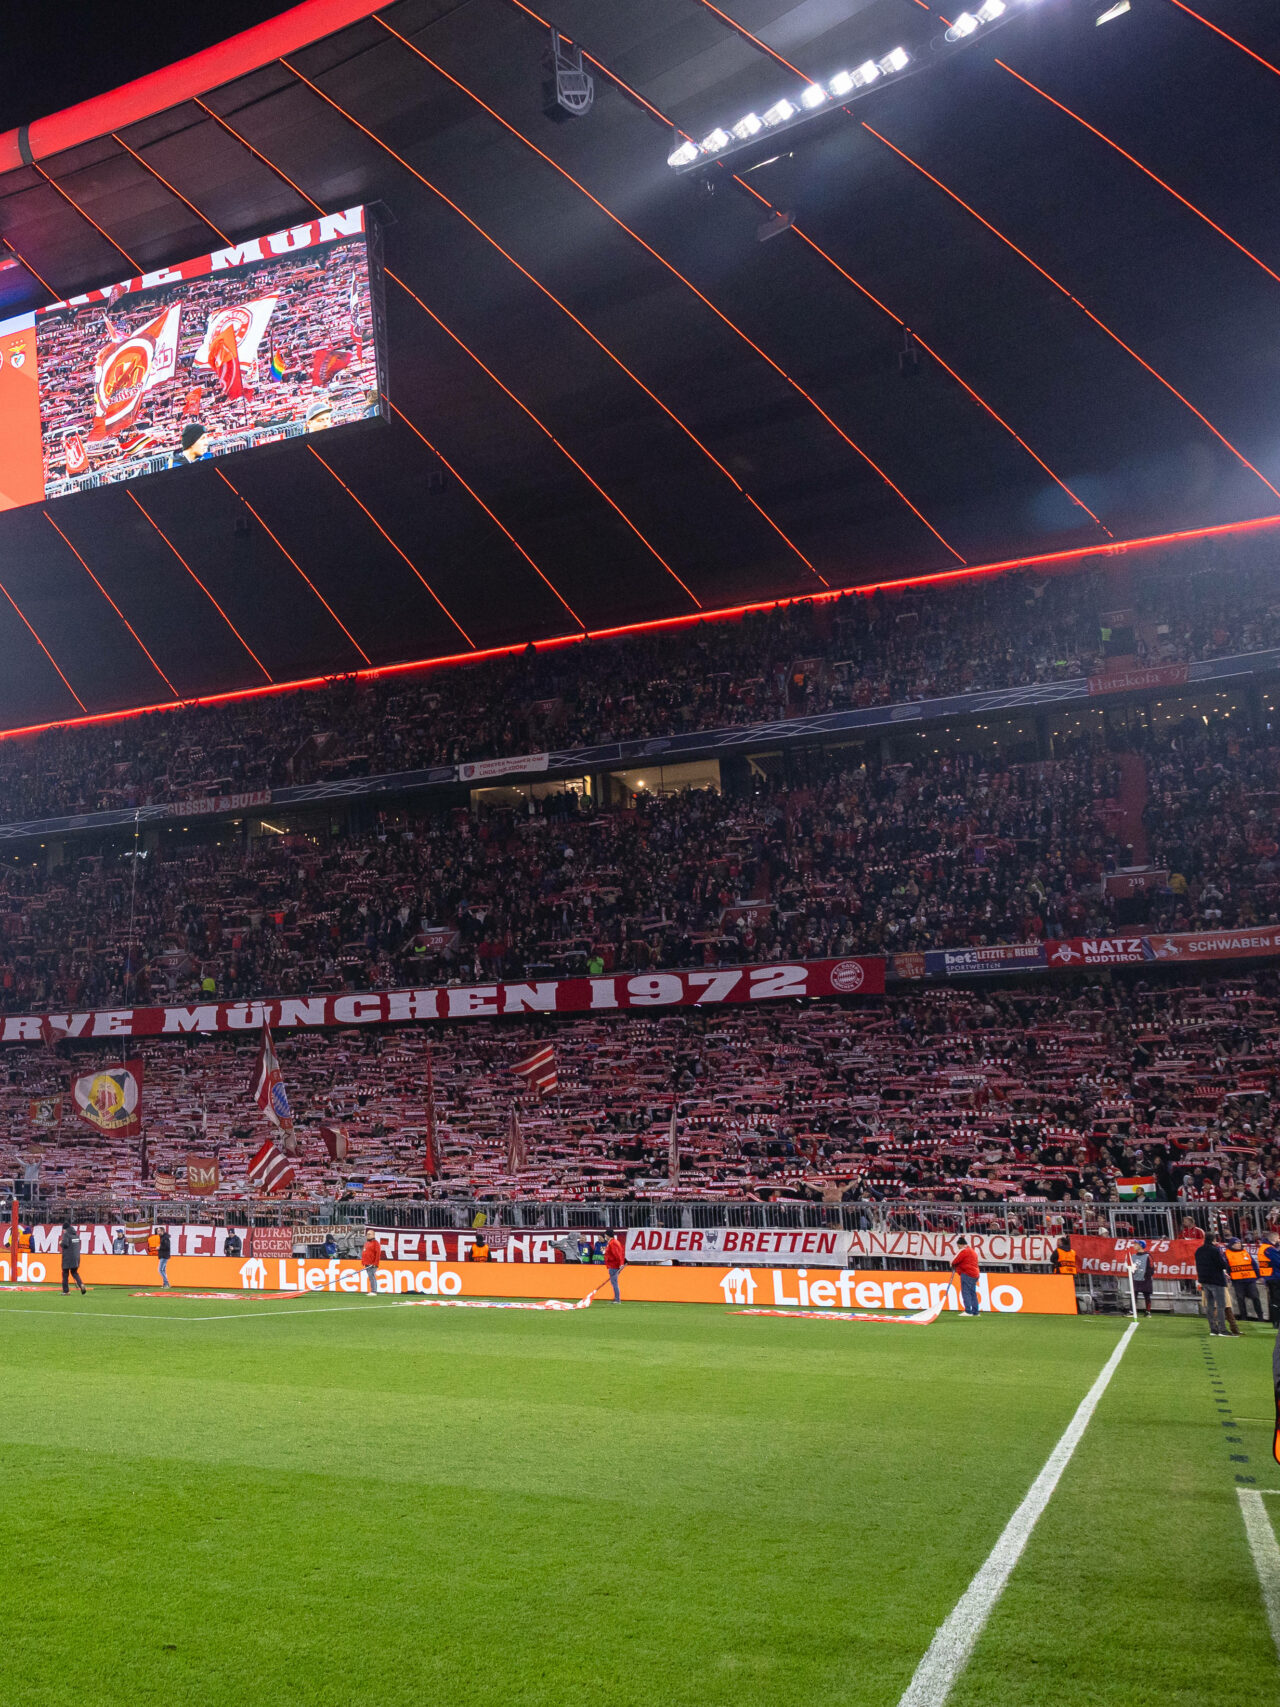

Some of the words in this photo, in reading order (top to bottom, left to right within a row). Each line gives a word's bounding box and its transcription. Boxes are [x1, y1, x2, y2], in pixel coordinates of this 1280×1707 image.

[1082, 939, 1142, 955] NATZ
[1188, 936, 1271, 952] SCHWABEN
[977, 948, 1006, 960] LETZTE
[946, 963, 1001, 971] SPORTWETTEN
[162, 980, 560, 1033] MÜNCHEN
[589, 965, 809, 1010] 1972
[189, 1166, 216, 1184] SM
[253, 1227, 292, 1238] ULTRAS
[252, 1240, 291, 1250] GEGEN
[293, 1235, 325, 1244] IMMER
[631, 1231, 704, 1251] ADLER
[722, 1232, 838, 1253] BRETTEN
[1150, 1240, 1171, 1253] 75
